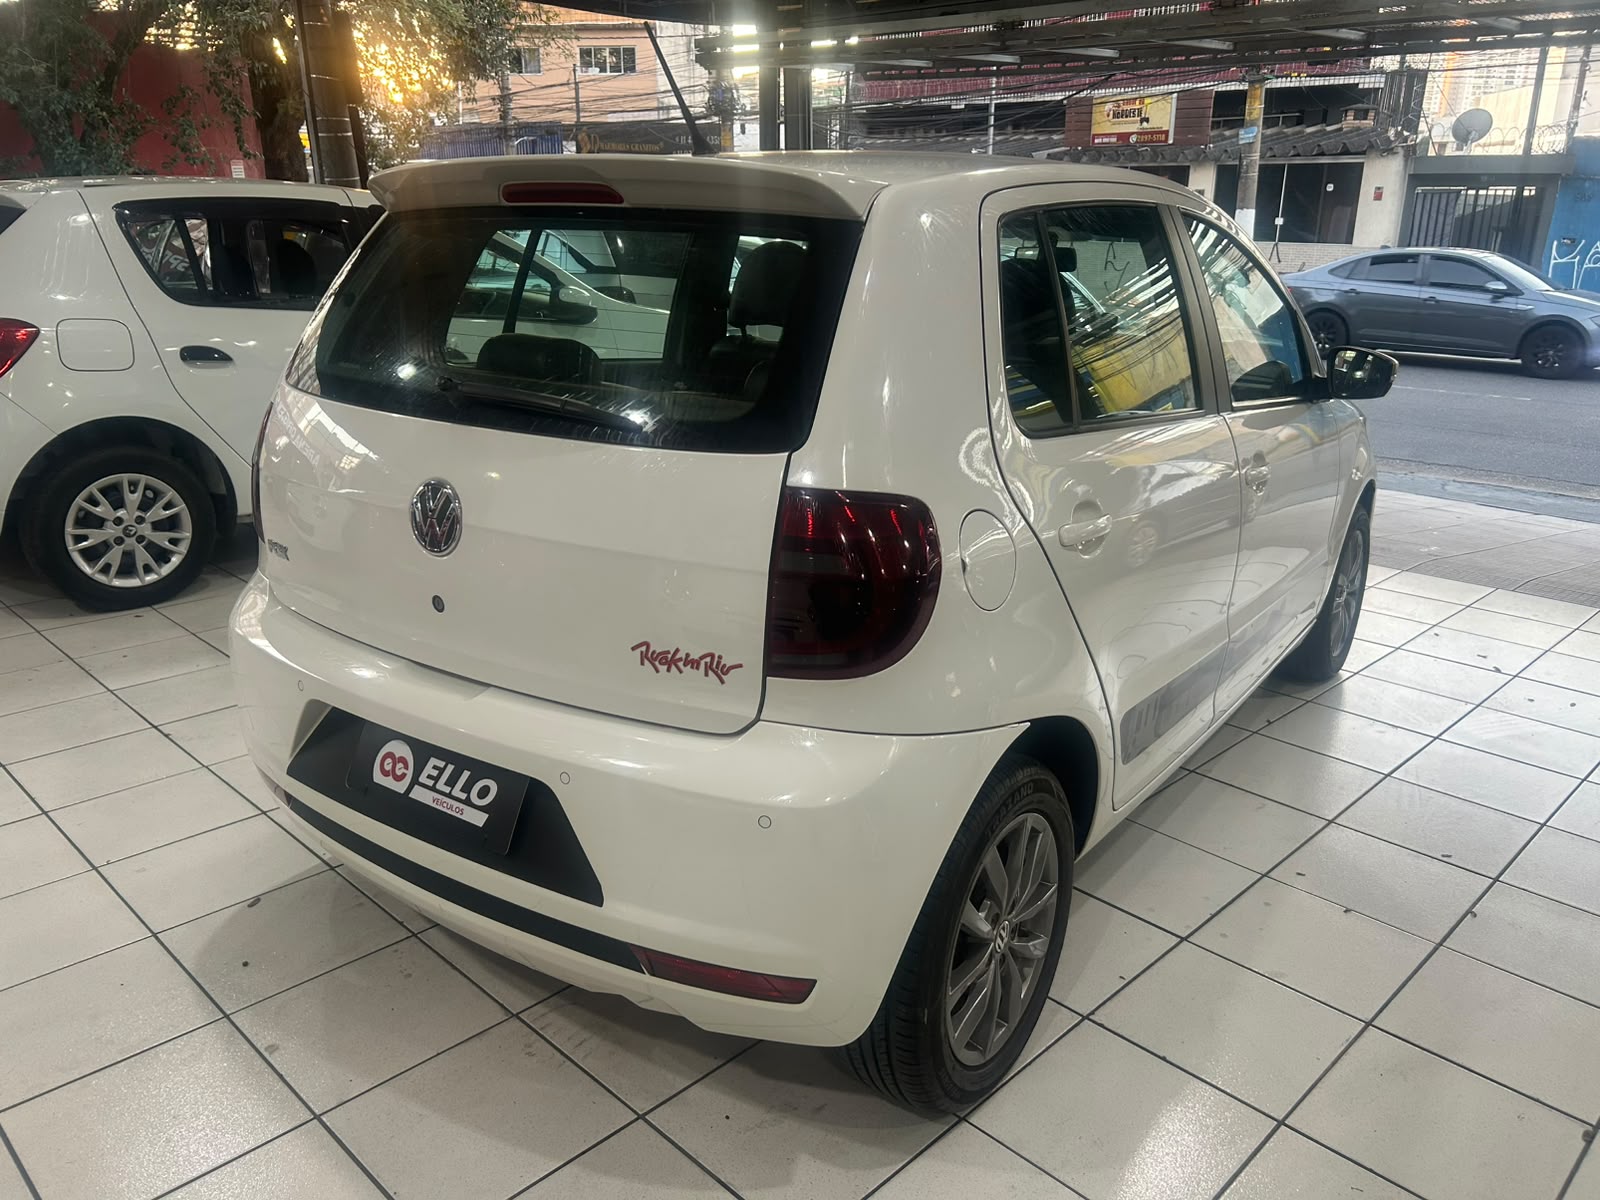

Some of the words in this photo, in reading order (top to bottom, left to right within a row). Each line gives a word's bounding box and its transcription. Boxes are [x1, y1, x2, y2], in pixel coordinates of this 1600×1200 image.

[631, 641, 683, 674] Rock
[699, 652, 743, 685] Rio
[418, 756, 498, 806] ELLO
[431, 795, 465, 816] VEÍCULOS
